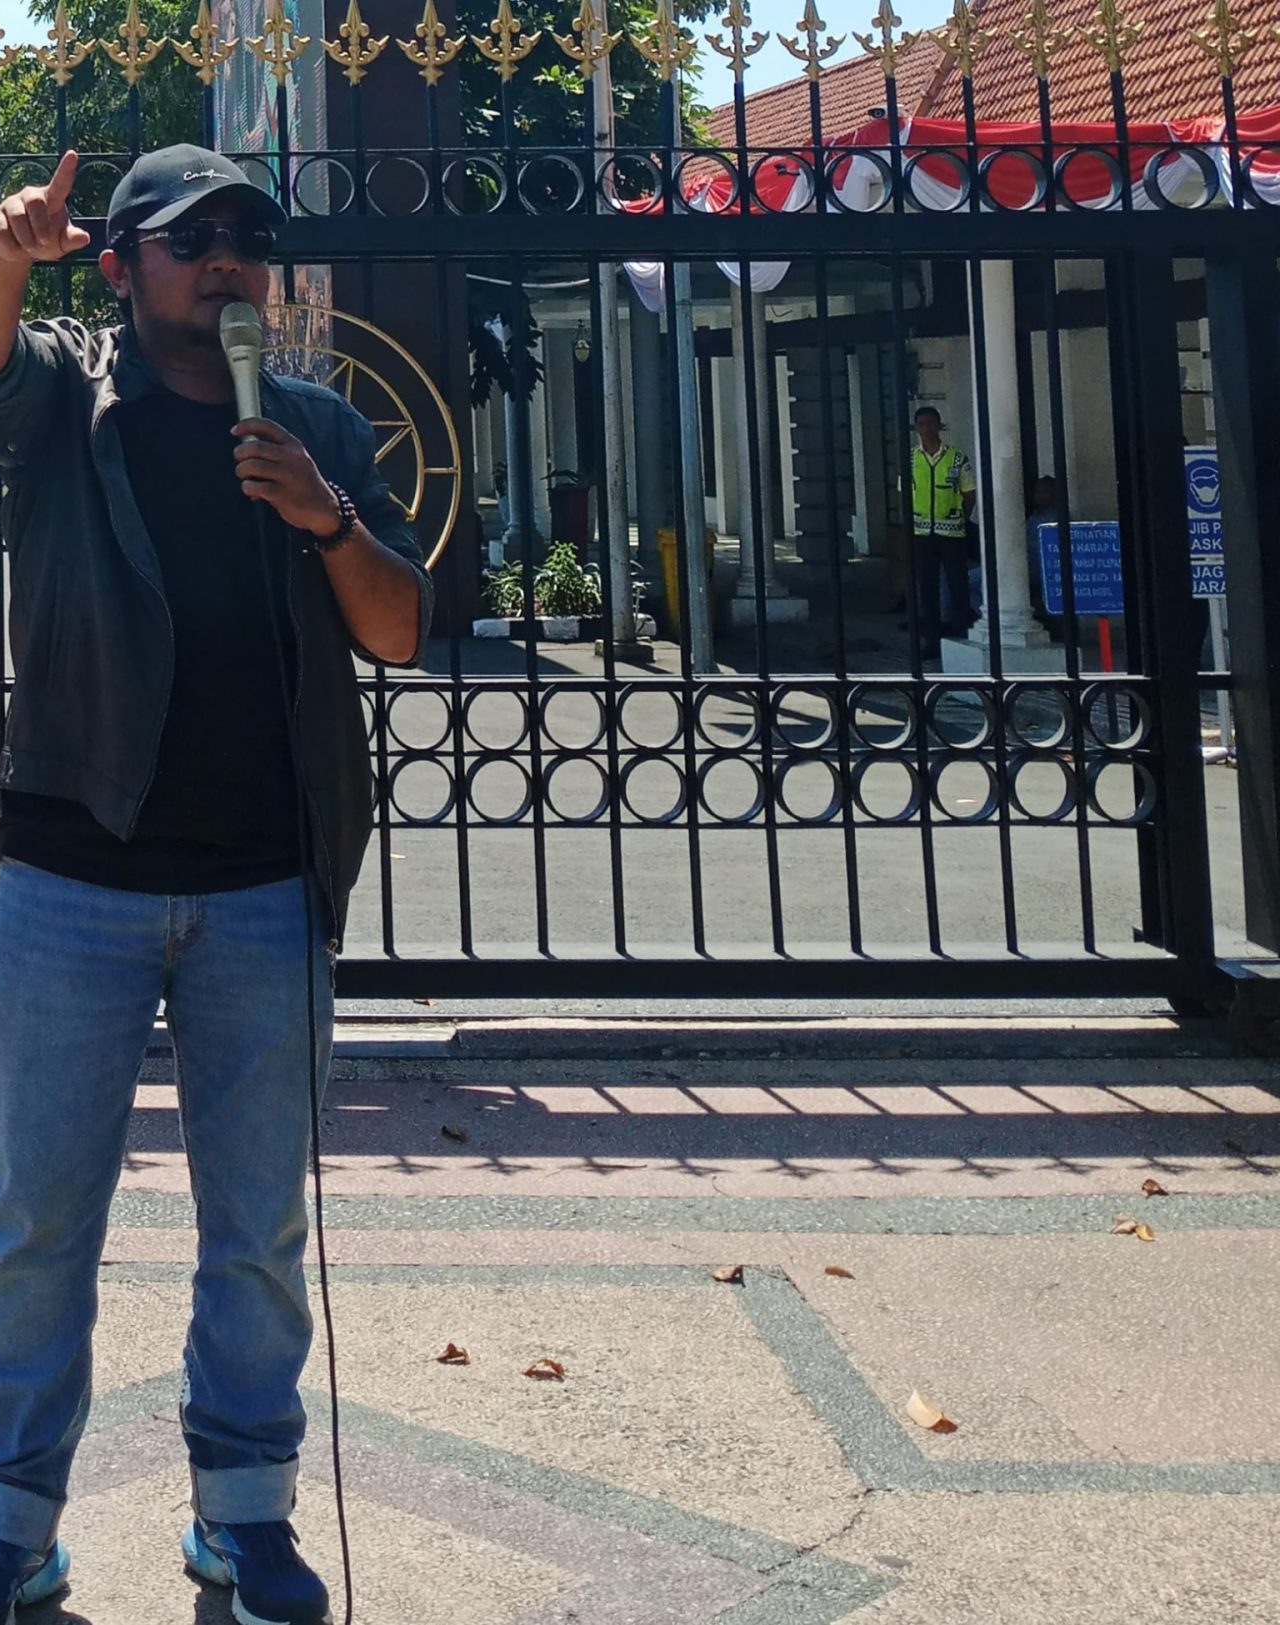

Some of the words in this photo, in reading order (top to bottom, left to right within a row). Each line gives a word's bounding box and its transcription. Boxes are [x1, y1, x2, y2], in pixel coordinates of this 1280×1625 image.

[1189, 522, 1210, 534] JIB
[1213, 522, 1223, 534] P
[1070, 529, 1117, 540] ERHATIAN
[1191, 538, 1223, 550] ASK
[1192, 566, 1224, 578] JAG
[1192, 580, 1226, 593] JARA
